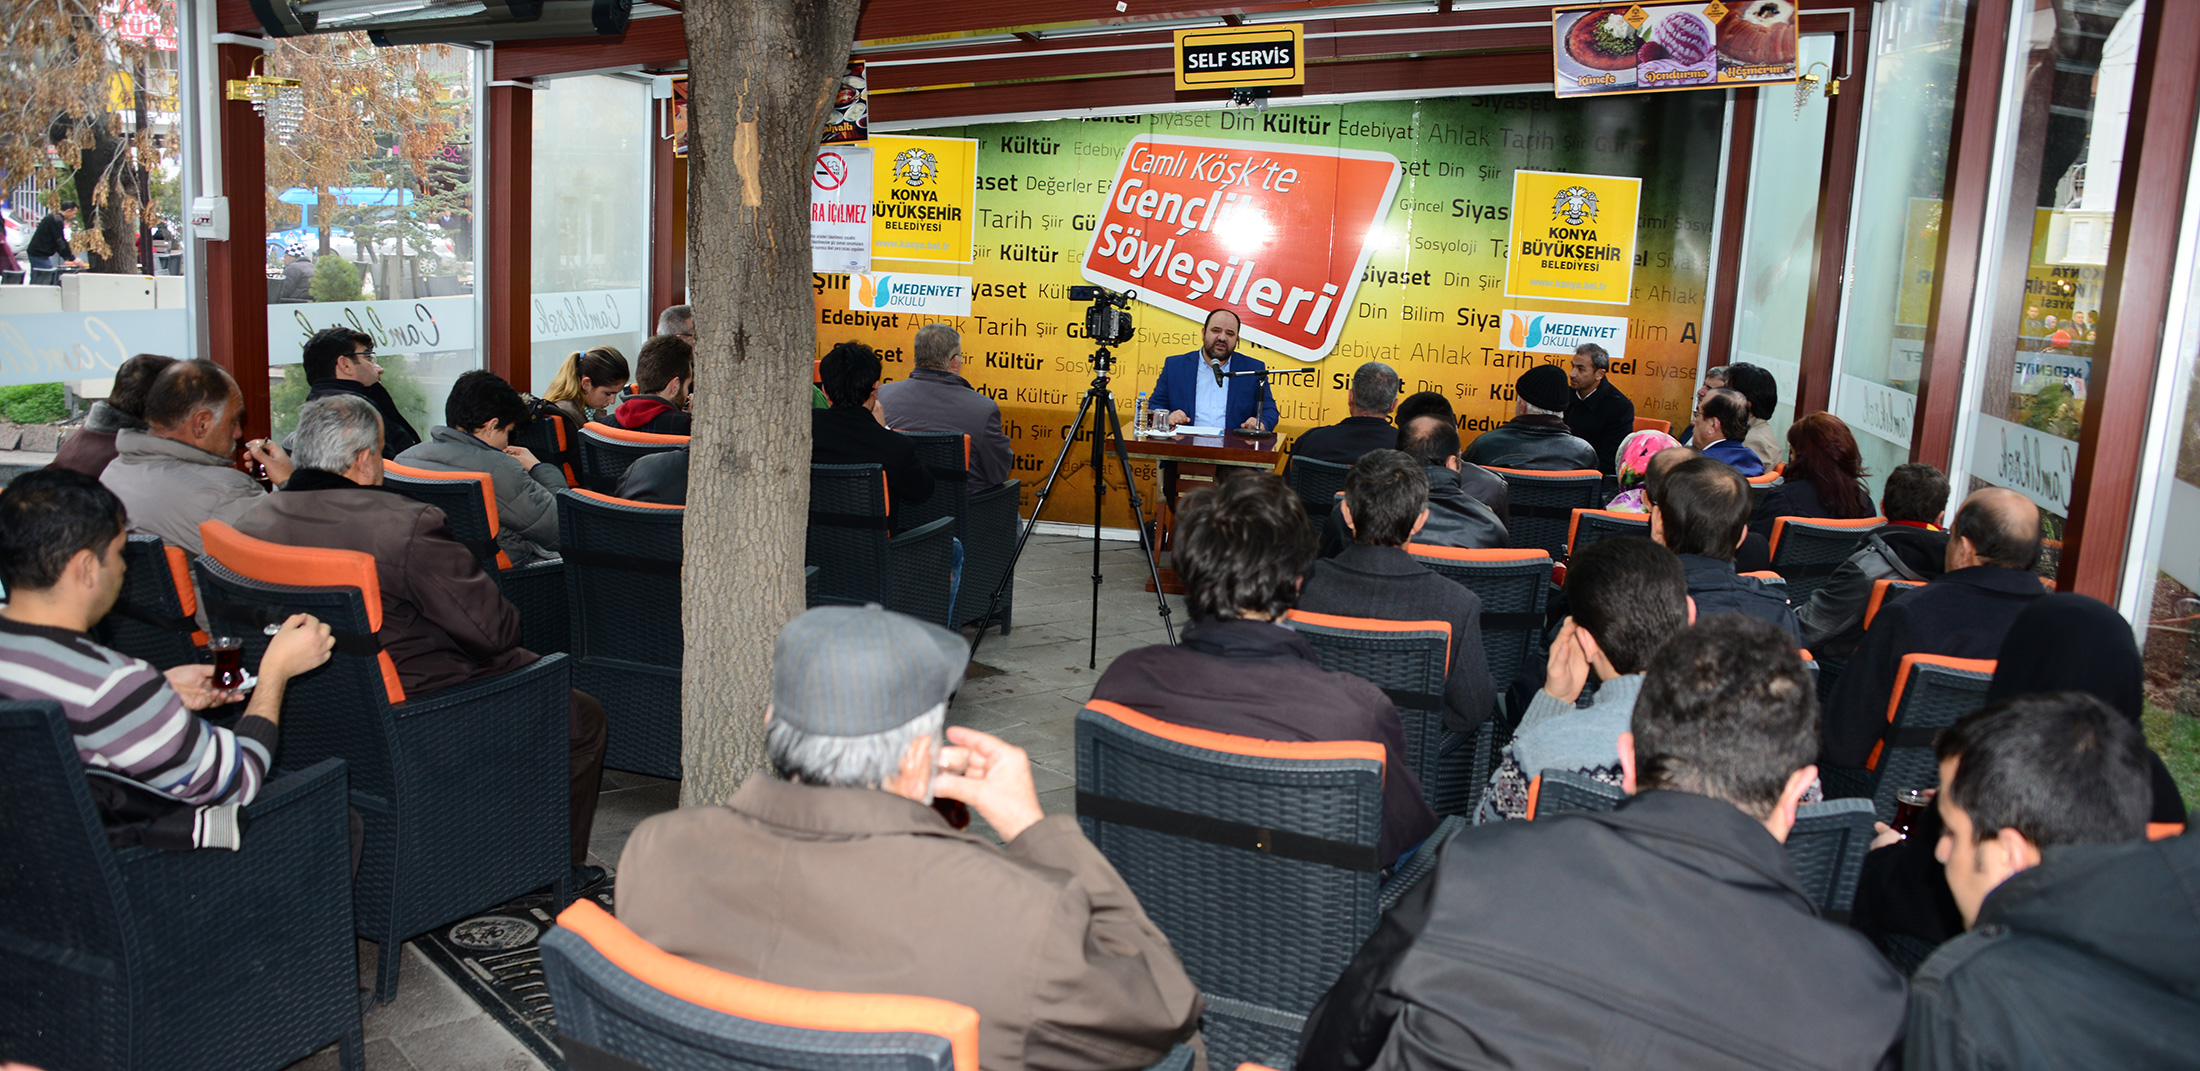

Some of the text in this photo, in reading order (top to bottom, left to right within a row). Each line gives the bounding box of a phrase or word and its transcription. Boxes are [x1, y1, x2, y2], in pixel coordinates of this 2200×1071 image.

[1188, 46, 1290, 69] SELF SERVİS
[1578, 75, 1616, 87] Künefe
[1645, 70, 1709, 83] Dondurma
[1727, 64, 1785, 79] Höşmerim
[823, 122, 853, 134] ahvaltı
[1221, 111, 1254, 131] Din
[1263, 112, 1331, 135] Kültür
[1338, 119, 1414, 142] Edebiyat
[1427, 122, 1491, 147] Ahlak
[1499, 127, 1555, 151] Tarih
[1001, 136, 1061, 155] Kültür
[1130, 146, 1186, 179] Camlı
[1438, 161, 1465, 177] Din
[1478, 164, 1502, 181] Şiir
[891, 188, 938, 202] KONYA
[1026, 175, 1093, 196] Değerler
[827, 200, 867, 226] İÇİLMEZ
[979, 208, 1032, 230] Tarih
[1041, 214, 1064, 231] Şiir
[1399, 198, 1510, 224] Güncel Siyas
[885, 221, 942, 232] BELEDİYESİ
[1548, 227, 1598, 242] KONYA
[875, 238, 951, 251] www.konya.bel.tr
[1000, 244, 1059, 263] Kültür
[1415, 236, 1477, 256] Sosyoloji
[1522, 239, 1621, 262] BÜYÜKŞEHİR
[1540, 259, 1600, 272] BELEDİYESİ
[1097, 223, 1339, 336] Söyleşileri
[1360, 265, 1502, 291] Siyaset Din Şiir
[1529, 277, 1608, 292] www.konya.bel.tr
[890, 295, 926, 307] OKULU
[1647, 285, 1698, 305] Ahlak
[1359, 302, 1388, 319] Din
[1402, 305, 1445, 322] Bilim
[821, 308, 899, 331] Edebiyat
[974, 315, 1027, 337] Tarih
[1036, 322, 1059, 338] Şiir
[1627, 318, 1667, 341] ilim
[1137, 327, 1198, 347] Siyaset
[1542, 335, 1579, 348] OKULU
[986, 351, 1044, 370] Kültür
[1330, 339, 1401, 361] debiyat
[1409, 342, 1472, 365] Ahlak
[1480, 347, 1534, 369] Tarih
[1016, 387, 1069, 405] Kültür
[1455, 383, 1478, 399] Şiir
[1278, 400, 1331, 421] ültür
[1643, 396, 1680, 411] Ahlak
[1031, 424, 1053, 440] Şiir
